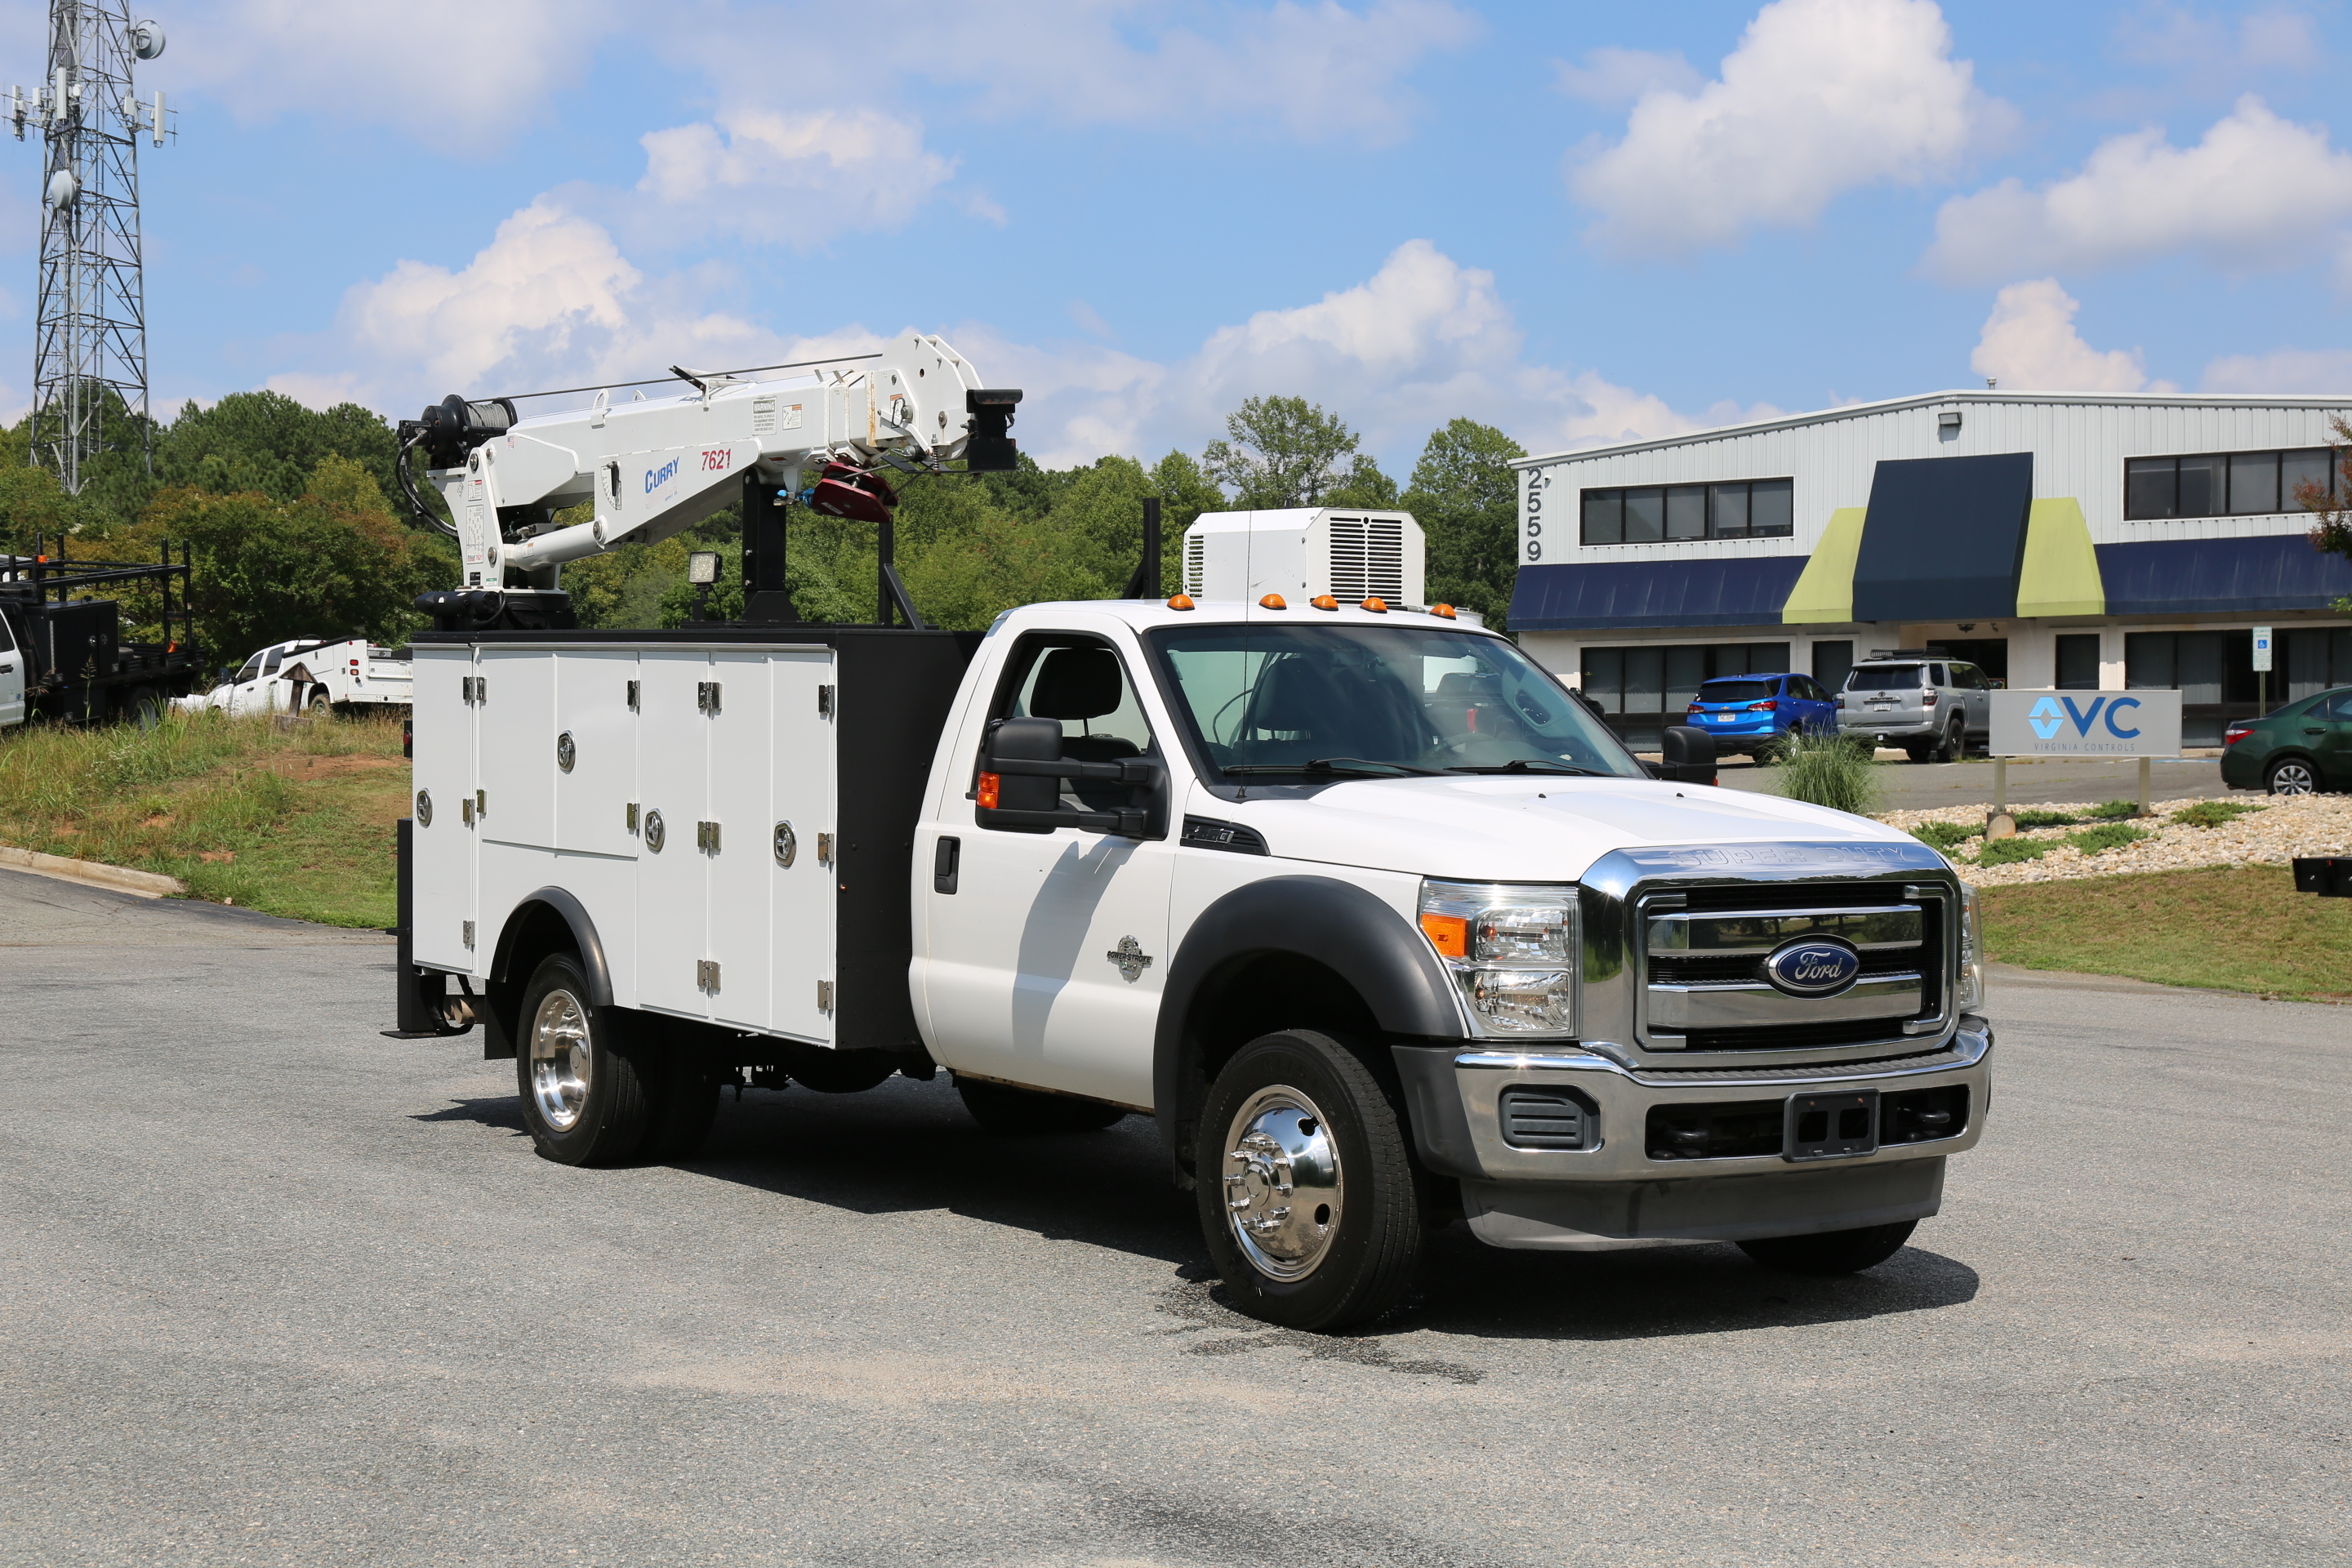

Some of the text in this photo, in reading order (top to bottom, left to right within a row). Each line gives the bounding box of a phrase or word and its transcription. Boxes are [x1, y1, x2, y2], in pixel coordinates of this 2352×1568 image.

[754, 402, 775, 412] WARNING
[702, 448, 731, 471] 7621
[645, 456, 679, 493] CURRY
[1527, 467, 1542, 562] 2559
[2034, 742, 2135, 751] VIRGINIA CONTROLS
[1668, 847, 1906, 866] SUPER DUTY
[1794, 951, 1843, 980] Ford
